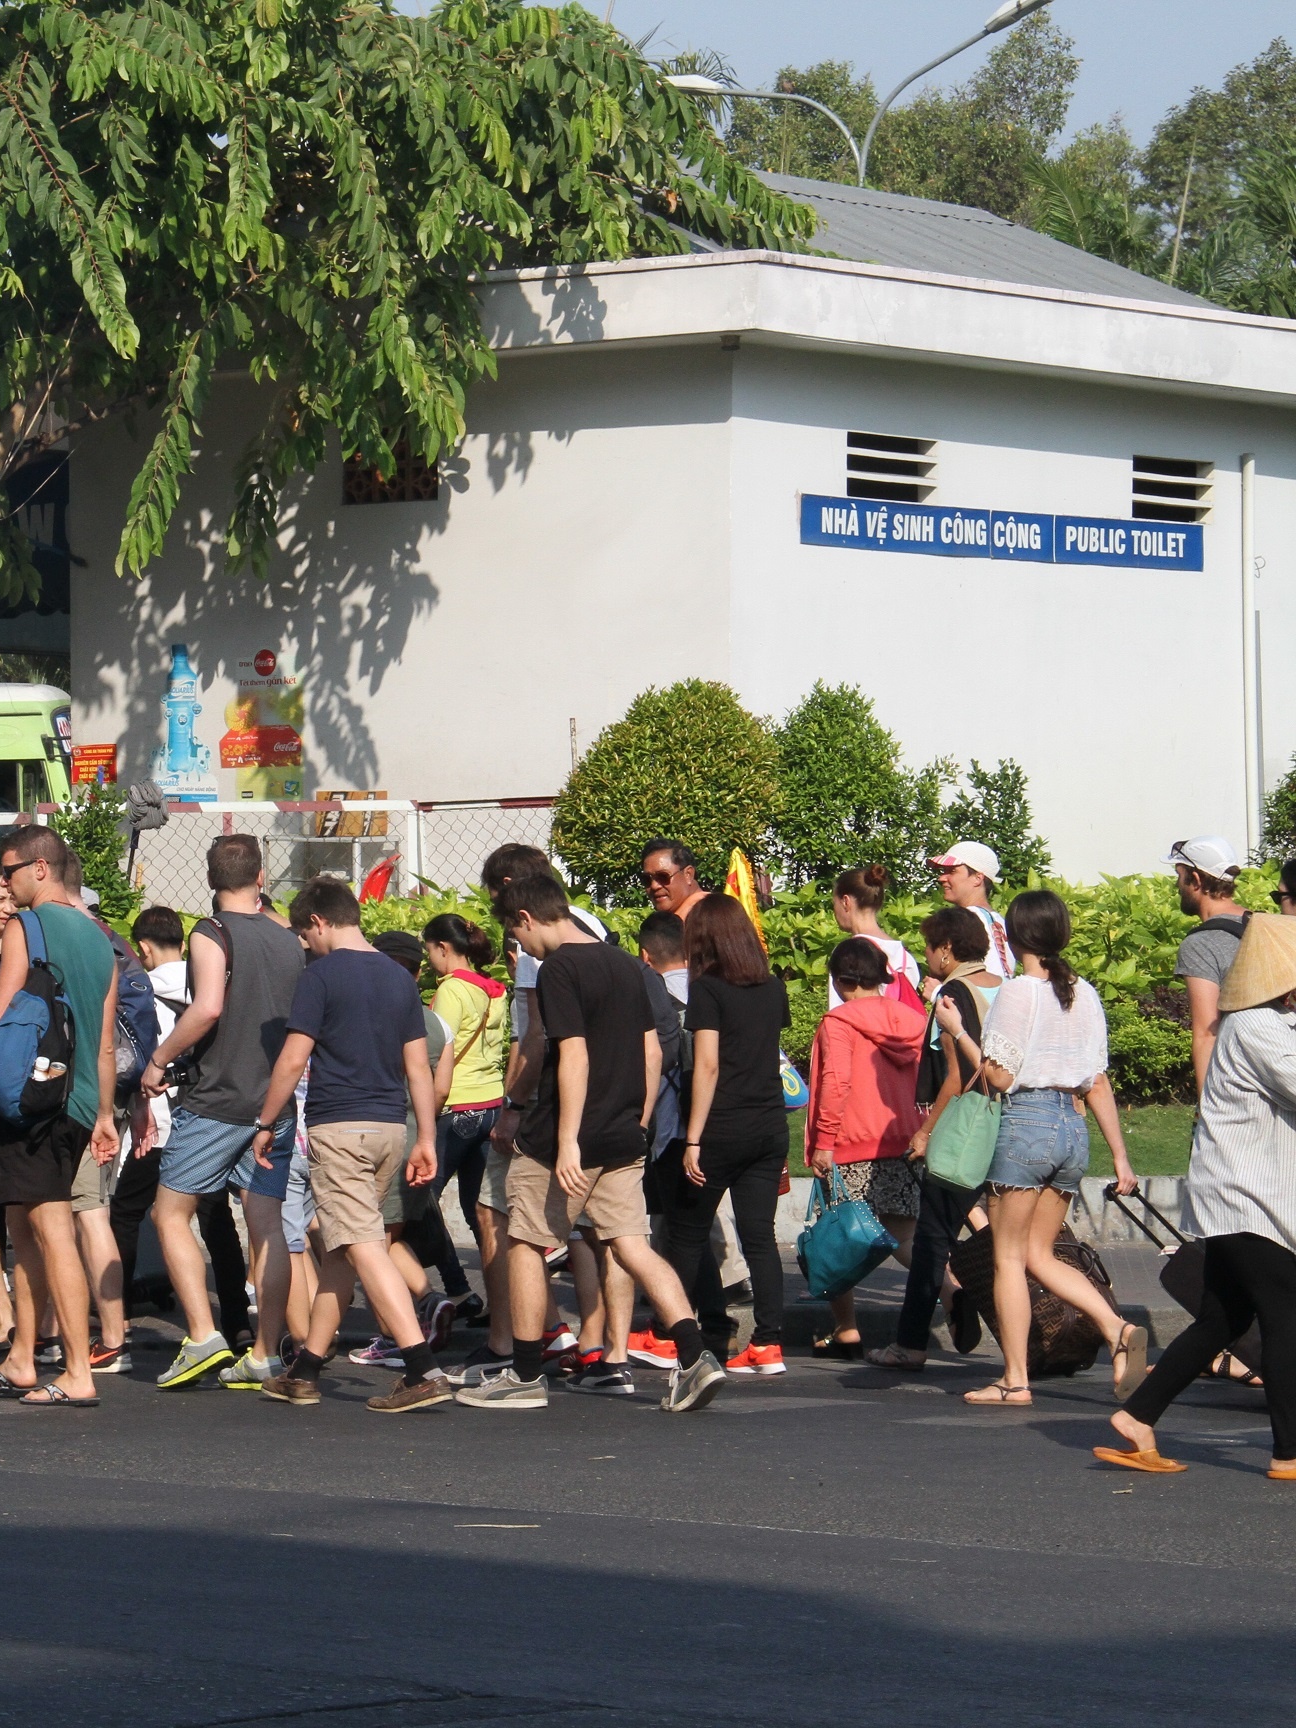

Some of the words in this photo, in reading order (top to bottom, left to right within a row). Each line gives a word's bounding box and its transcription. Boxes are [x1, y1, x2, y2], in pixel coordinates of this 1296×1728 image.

[821, 503, 859, 537] NHÀ
[865, 506, 888, 545] VỆ
[892, 513, 935, 543] SINH
[940, 512, 987, 546] CÔNG
[993, 516, 1042, 554] CỘNG
[1065, 525, 1126, 555] PUBLIC
[1131, 530, 1187, 558] TOILET
